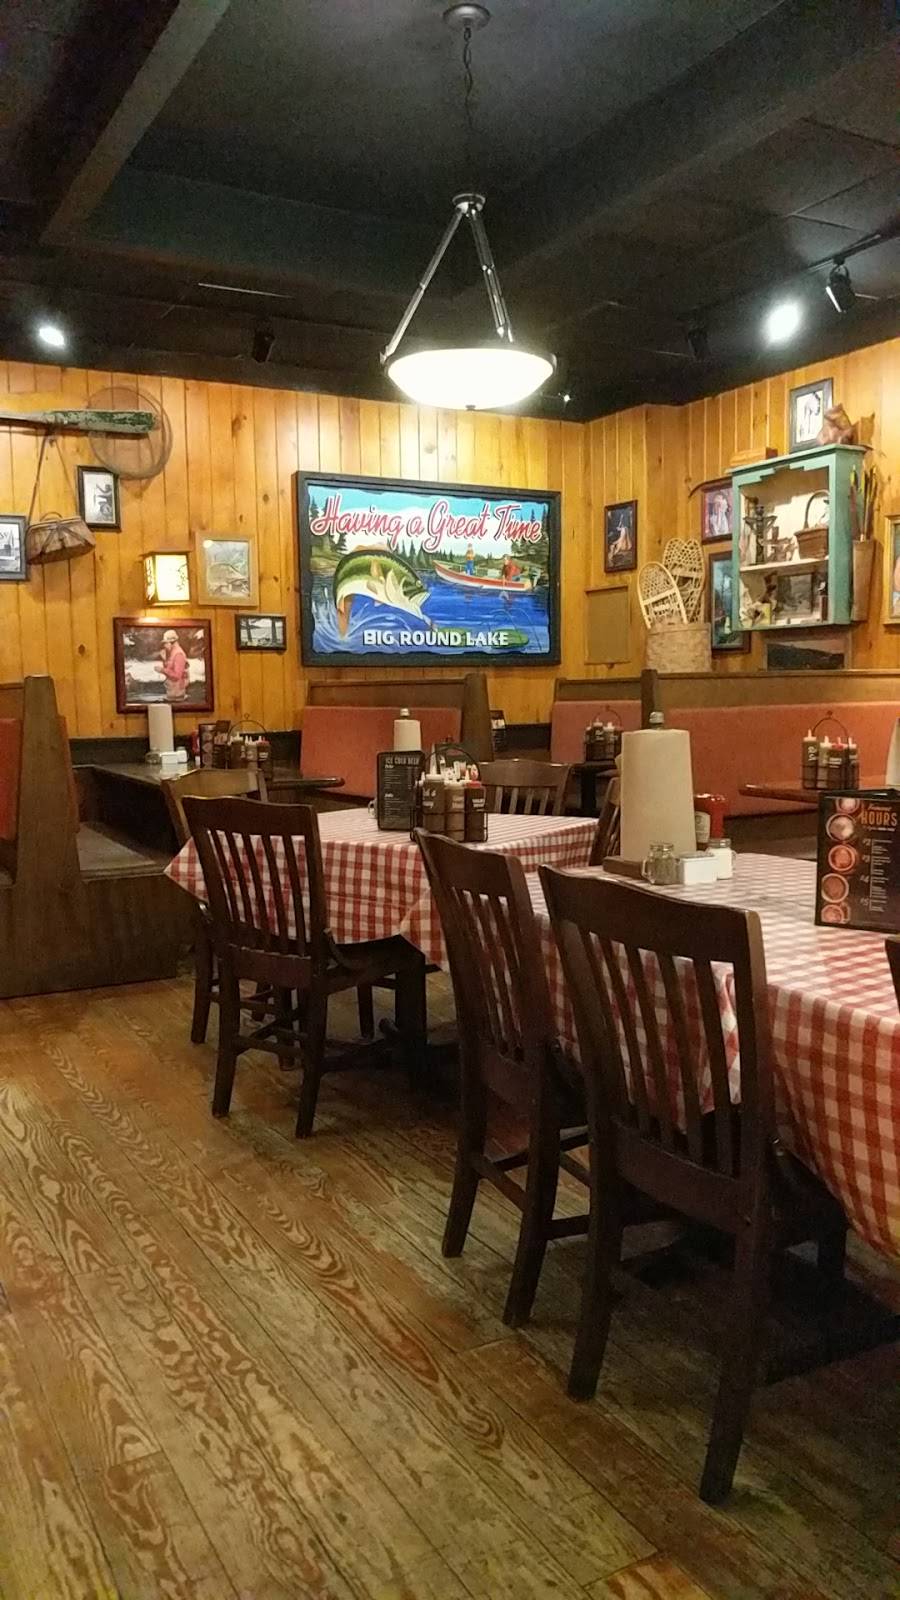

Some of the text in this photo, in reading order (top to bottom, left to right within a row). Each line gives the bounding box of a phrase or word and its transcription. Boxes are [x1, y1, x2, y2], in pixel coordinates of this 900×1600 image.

[311, 494, 542, 552] Having a Great Time
[363, 629, 509, 647] BIG ROUND LAKE
[860, 811, 898, 826] HOURS
